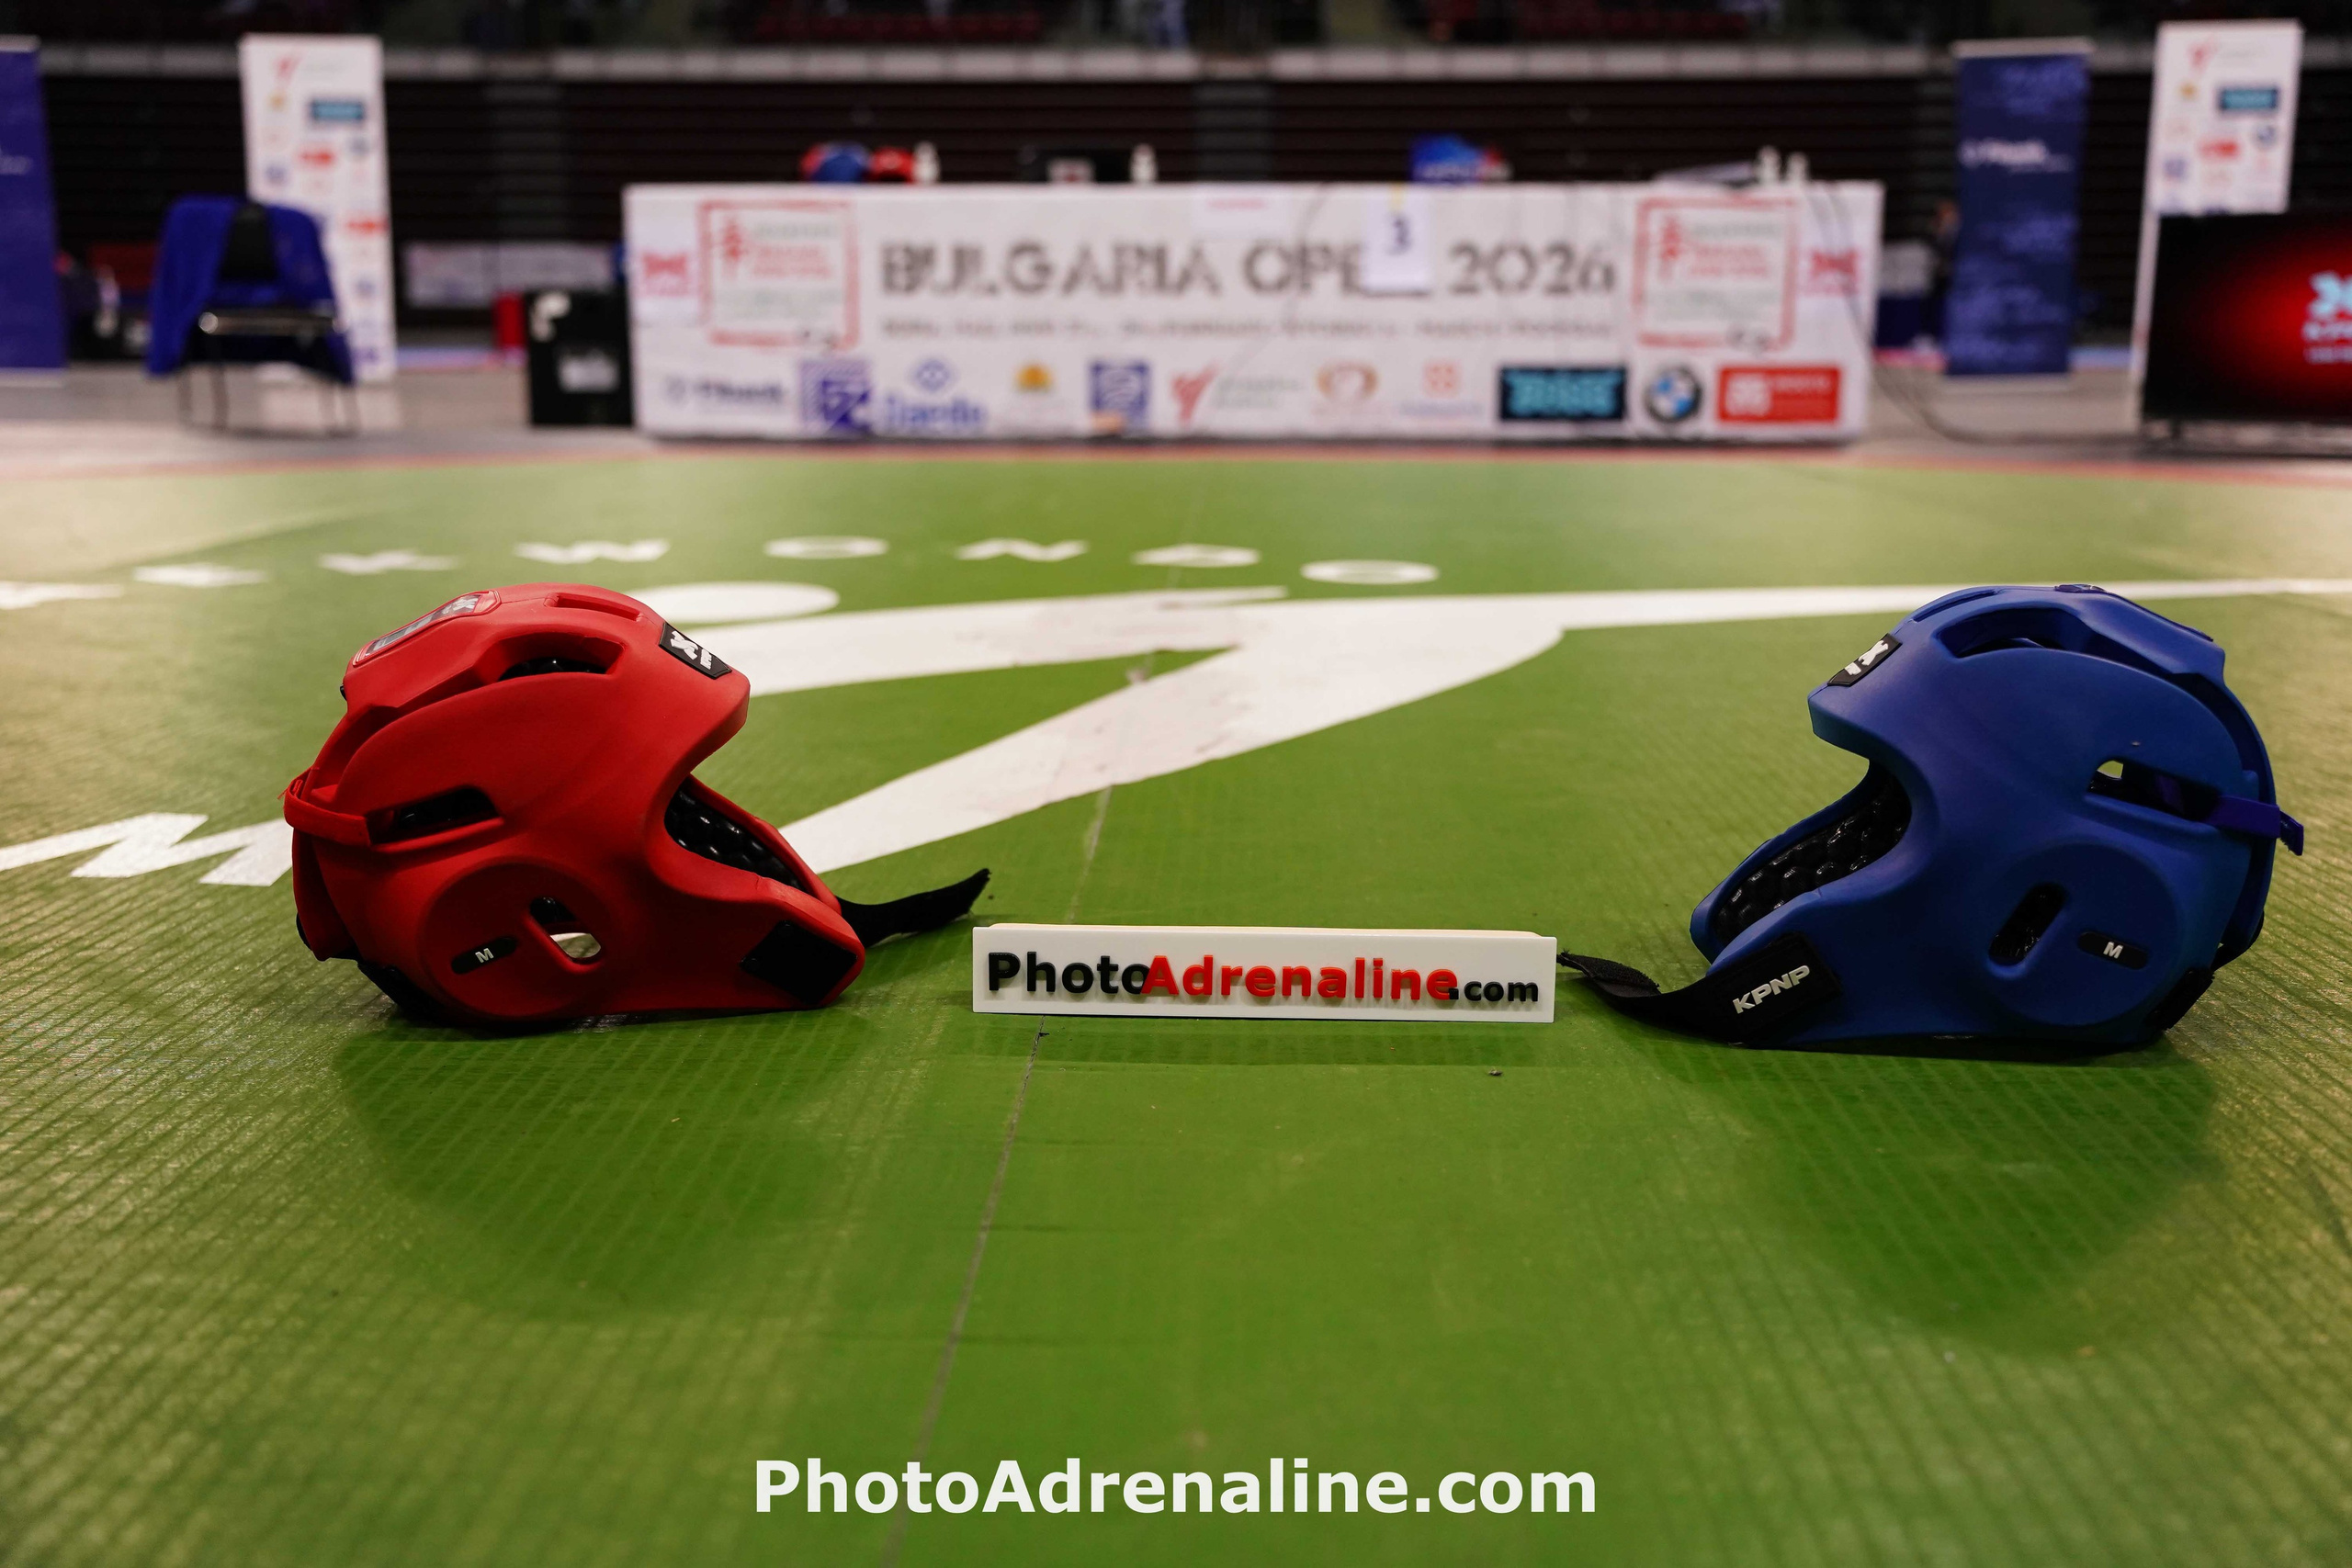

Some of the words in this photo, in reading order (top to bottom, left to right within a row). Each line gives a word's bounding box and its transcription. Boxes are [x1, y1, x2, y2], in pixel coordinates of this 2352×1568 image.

[879, 240, 1223, 297] BULGARIA
[1243, 240, 1366, 297] OPE
[1447, 240, 1616, 297] 2026
[475, 948, 494, 964] M
[2103, 942, 2124, 960] M
[988, 951, 1539, 1002] PhotoAdrenaline.com
[1733, 964, 1811, 1014] KPNP
